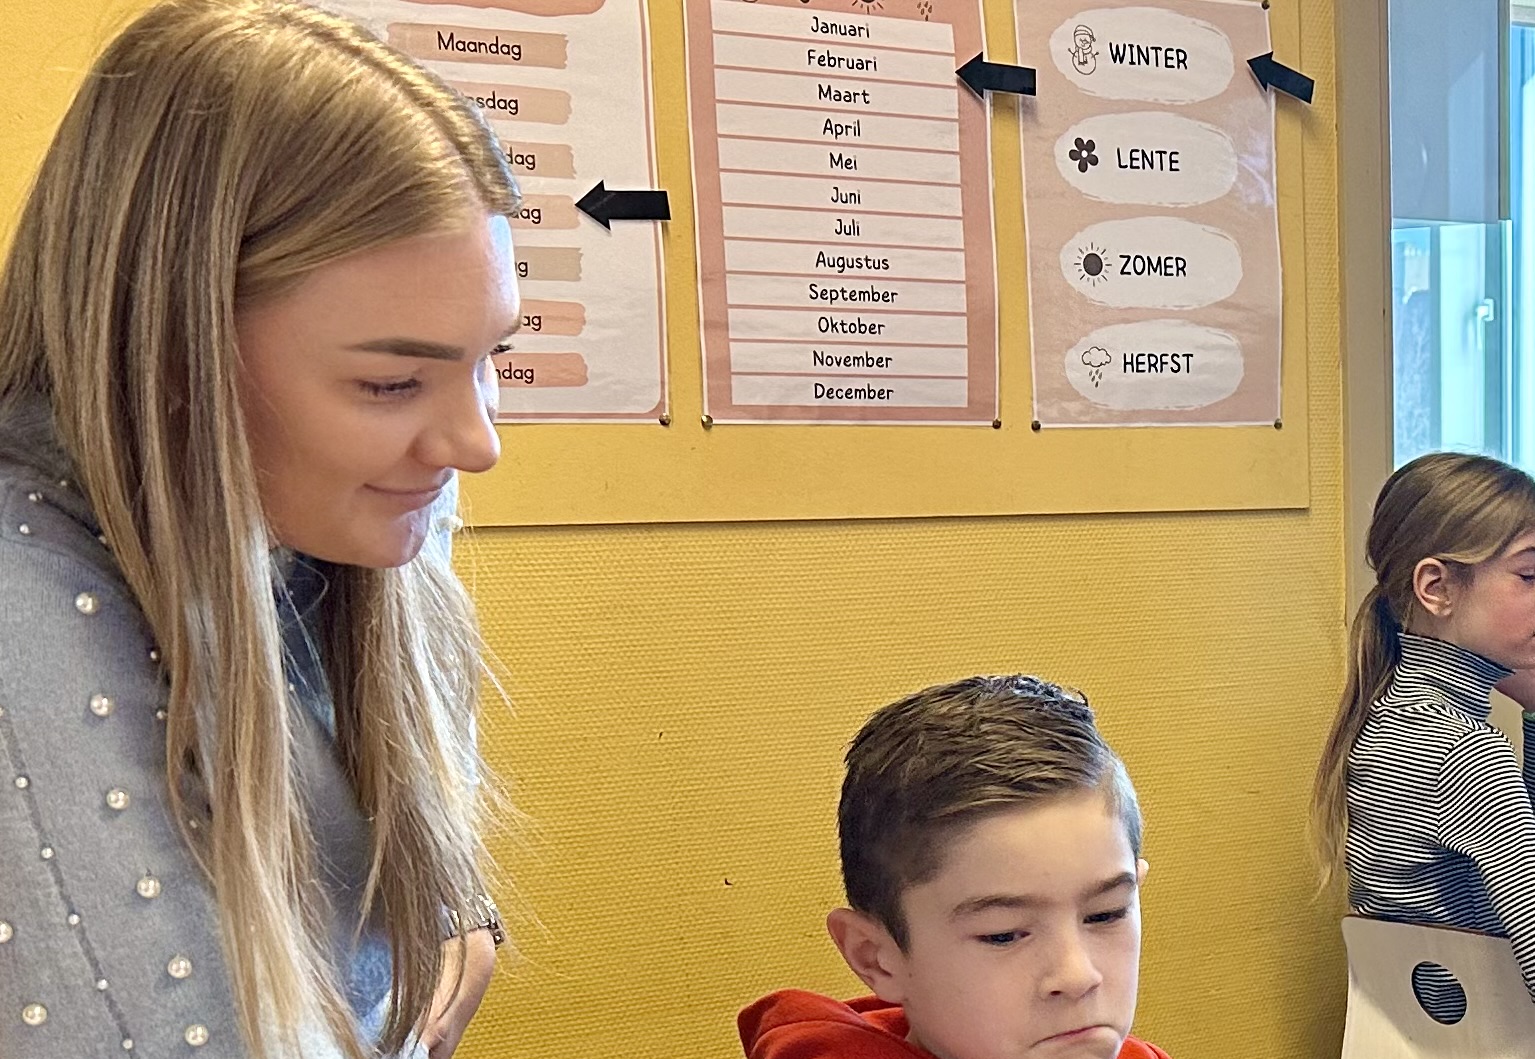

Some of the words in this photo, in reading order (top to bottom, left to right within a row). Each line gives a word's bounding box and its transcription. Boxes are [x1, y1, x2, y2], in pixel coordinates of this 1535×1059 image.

[810, 15, 870, 39] Januari
[437, 30, 522, 62] Maandag
[1108, 41, 1188, 70] WINTER
[807, 49, 877, 72] Februari
[817, 83, 871, 105] Maart
[822, 117, 861, 140] April
[829, 151, 858, 171] Mei
[1116, 147, 1180, 172] LENTE
[830, 186, 861, 205] Juni
[834, 218, 860, 237] Juli
[815, 250, 890, 274] Augustus
[1118, 254, 1187, 278] ZOMER
[809, 283, 899, 305] September
[817, 316, 886, 336] Oktober
[812, 349, 893, 369] November
[1123, 352, 1194, 374] HERFST
[814, 382, 895, 400] December
